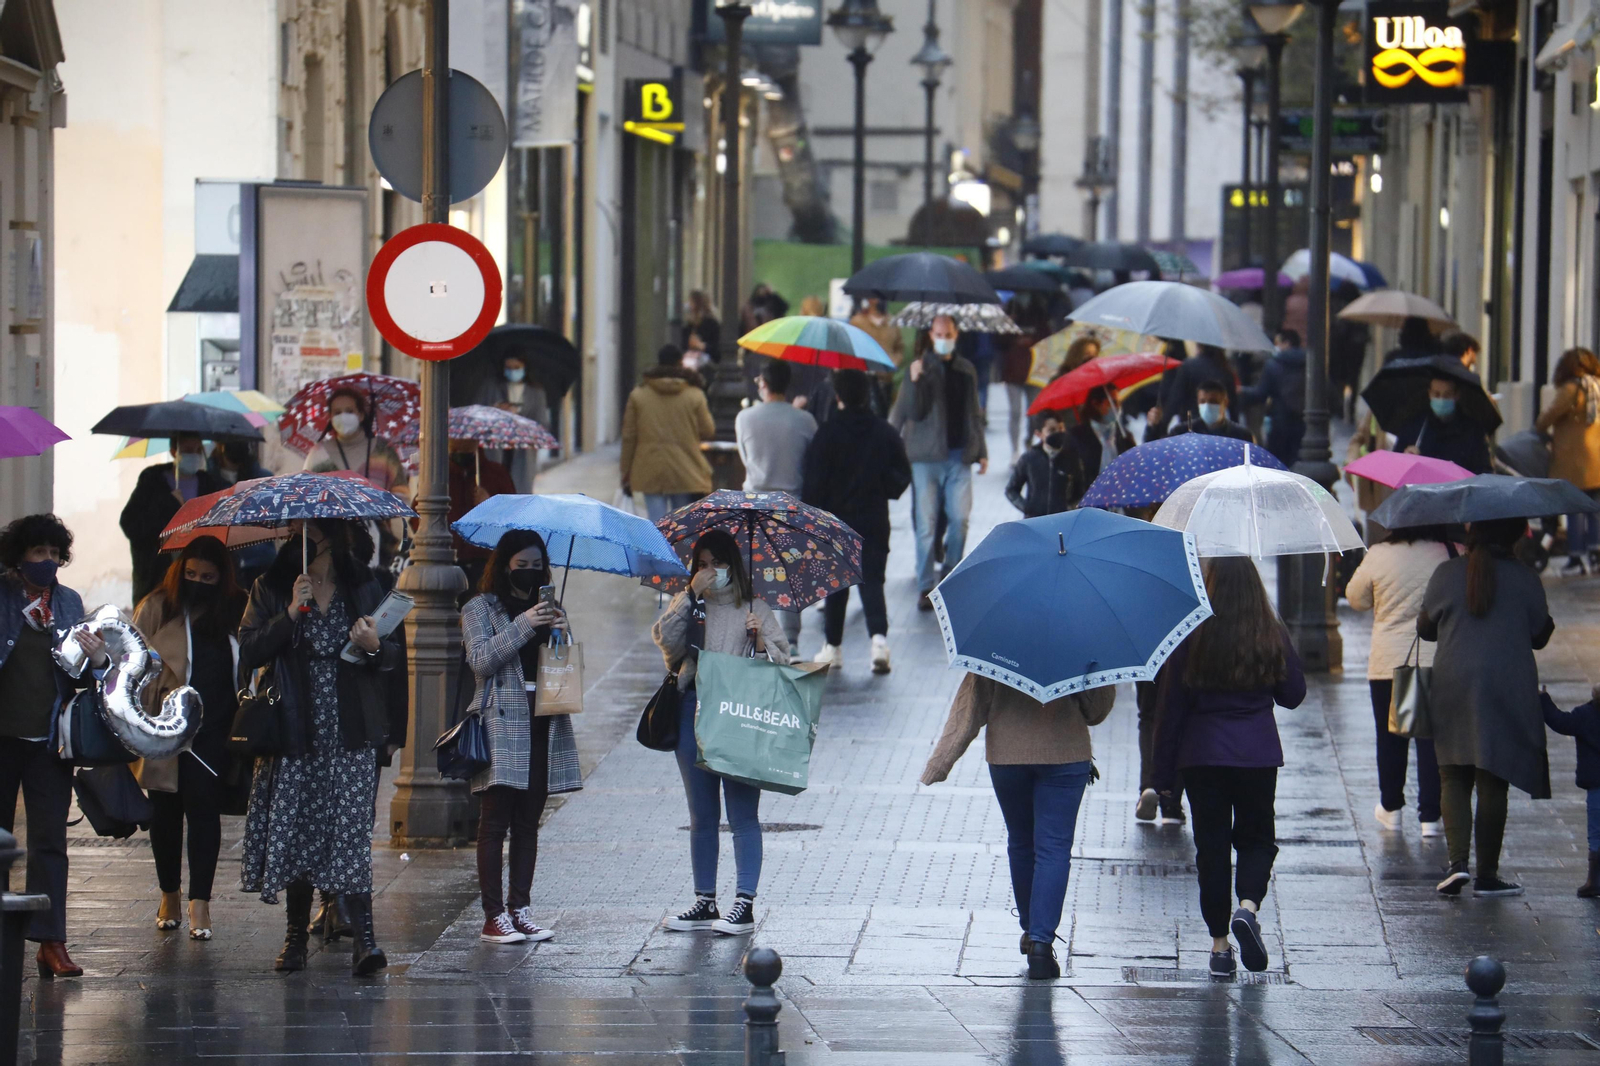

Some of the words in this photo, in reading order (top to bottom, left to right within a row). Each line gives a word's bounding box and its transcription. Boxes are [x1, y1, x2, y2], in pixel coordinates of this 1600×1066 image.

[1373, 15, 1466, 49] Ulloa
[521, 41, 545, 133] MATILDE
[641, 82, 673, 121] B
[719, 701, 801, 729] PULL&BEAR
